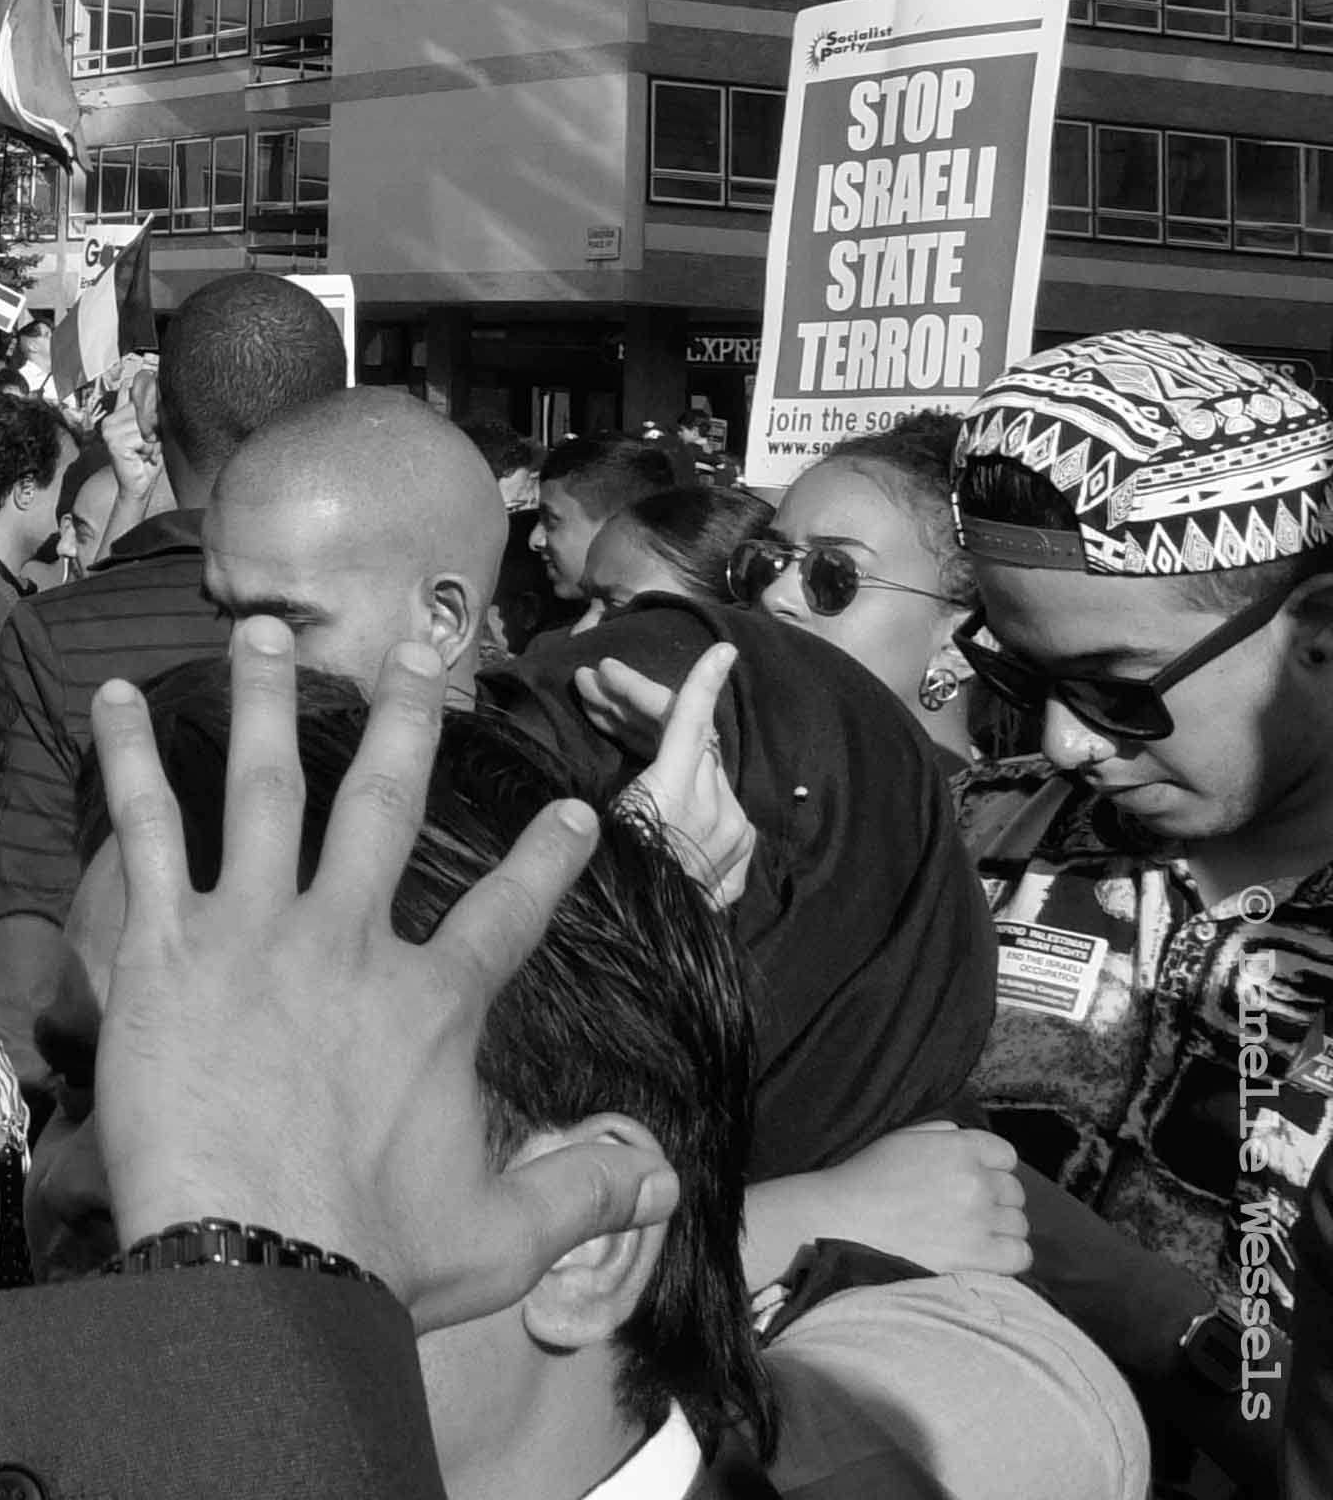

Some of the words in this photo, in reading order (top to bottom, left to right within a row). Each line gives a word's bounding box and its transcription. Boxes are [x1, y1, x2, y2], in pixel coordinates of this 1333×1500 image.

[821, 41, 867, 62] Party
[826, 26, 893, 46] Socialist
[848, 67, 975, 152] STOP
[813, 146, 998, 234] ISRAELI
[825, 230, 966, 312] STATE
[797, 314, 984, 394] TERROR
[766, 406, 812, 438] join
[822, 404, 857, 432] the
